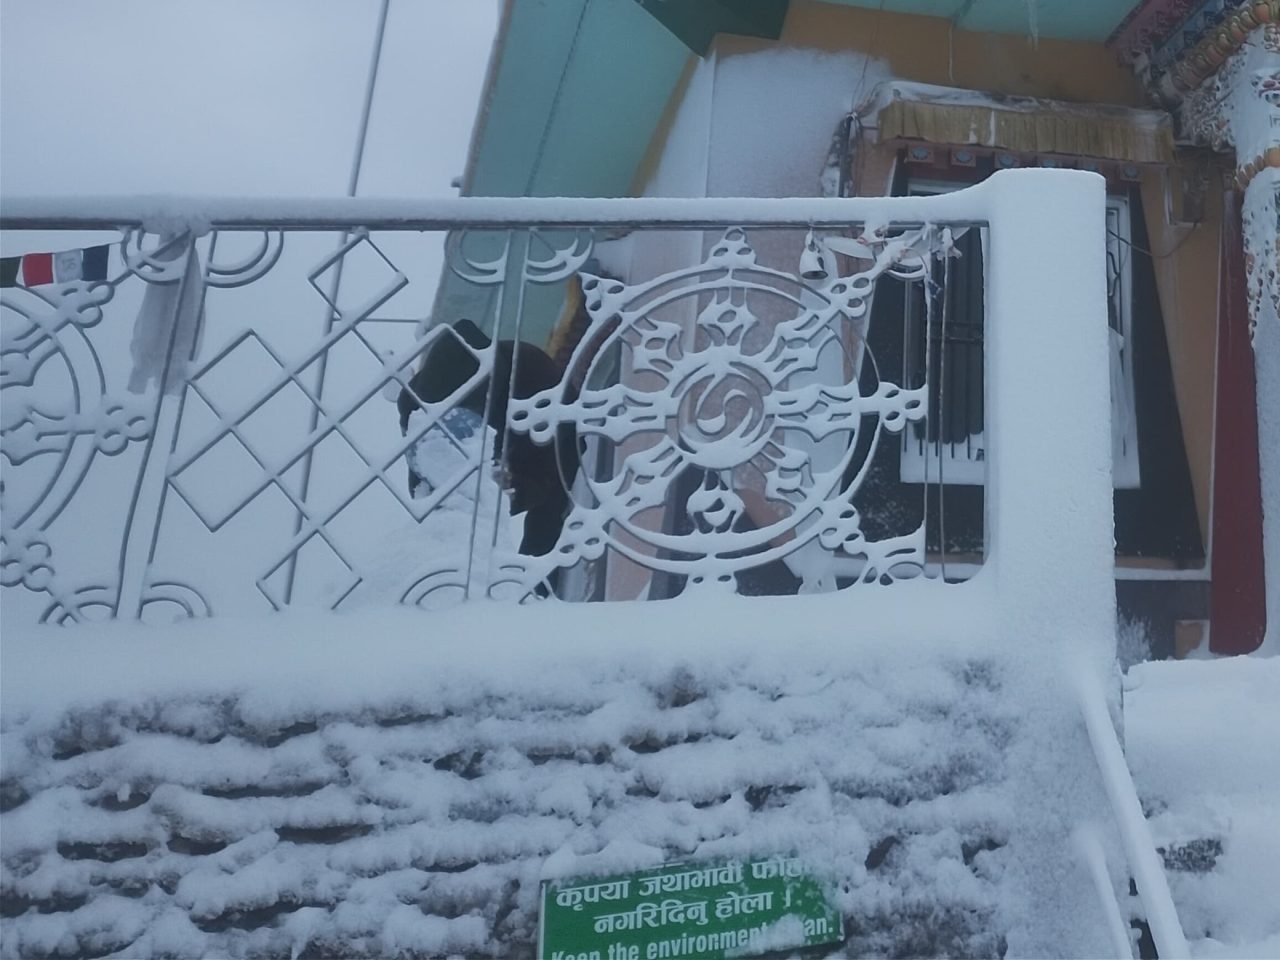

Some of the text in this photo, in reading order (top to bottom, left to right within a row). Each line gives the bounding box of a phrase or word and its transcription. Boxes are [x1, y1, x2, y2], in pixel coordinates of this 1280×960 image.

[556, 881, 630, 911] कृपया
[594, 899, 708, 933] नगरिदिनु
[714, 891, 773, 918] होला
[608, 942, 639, 960] the
